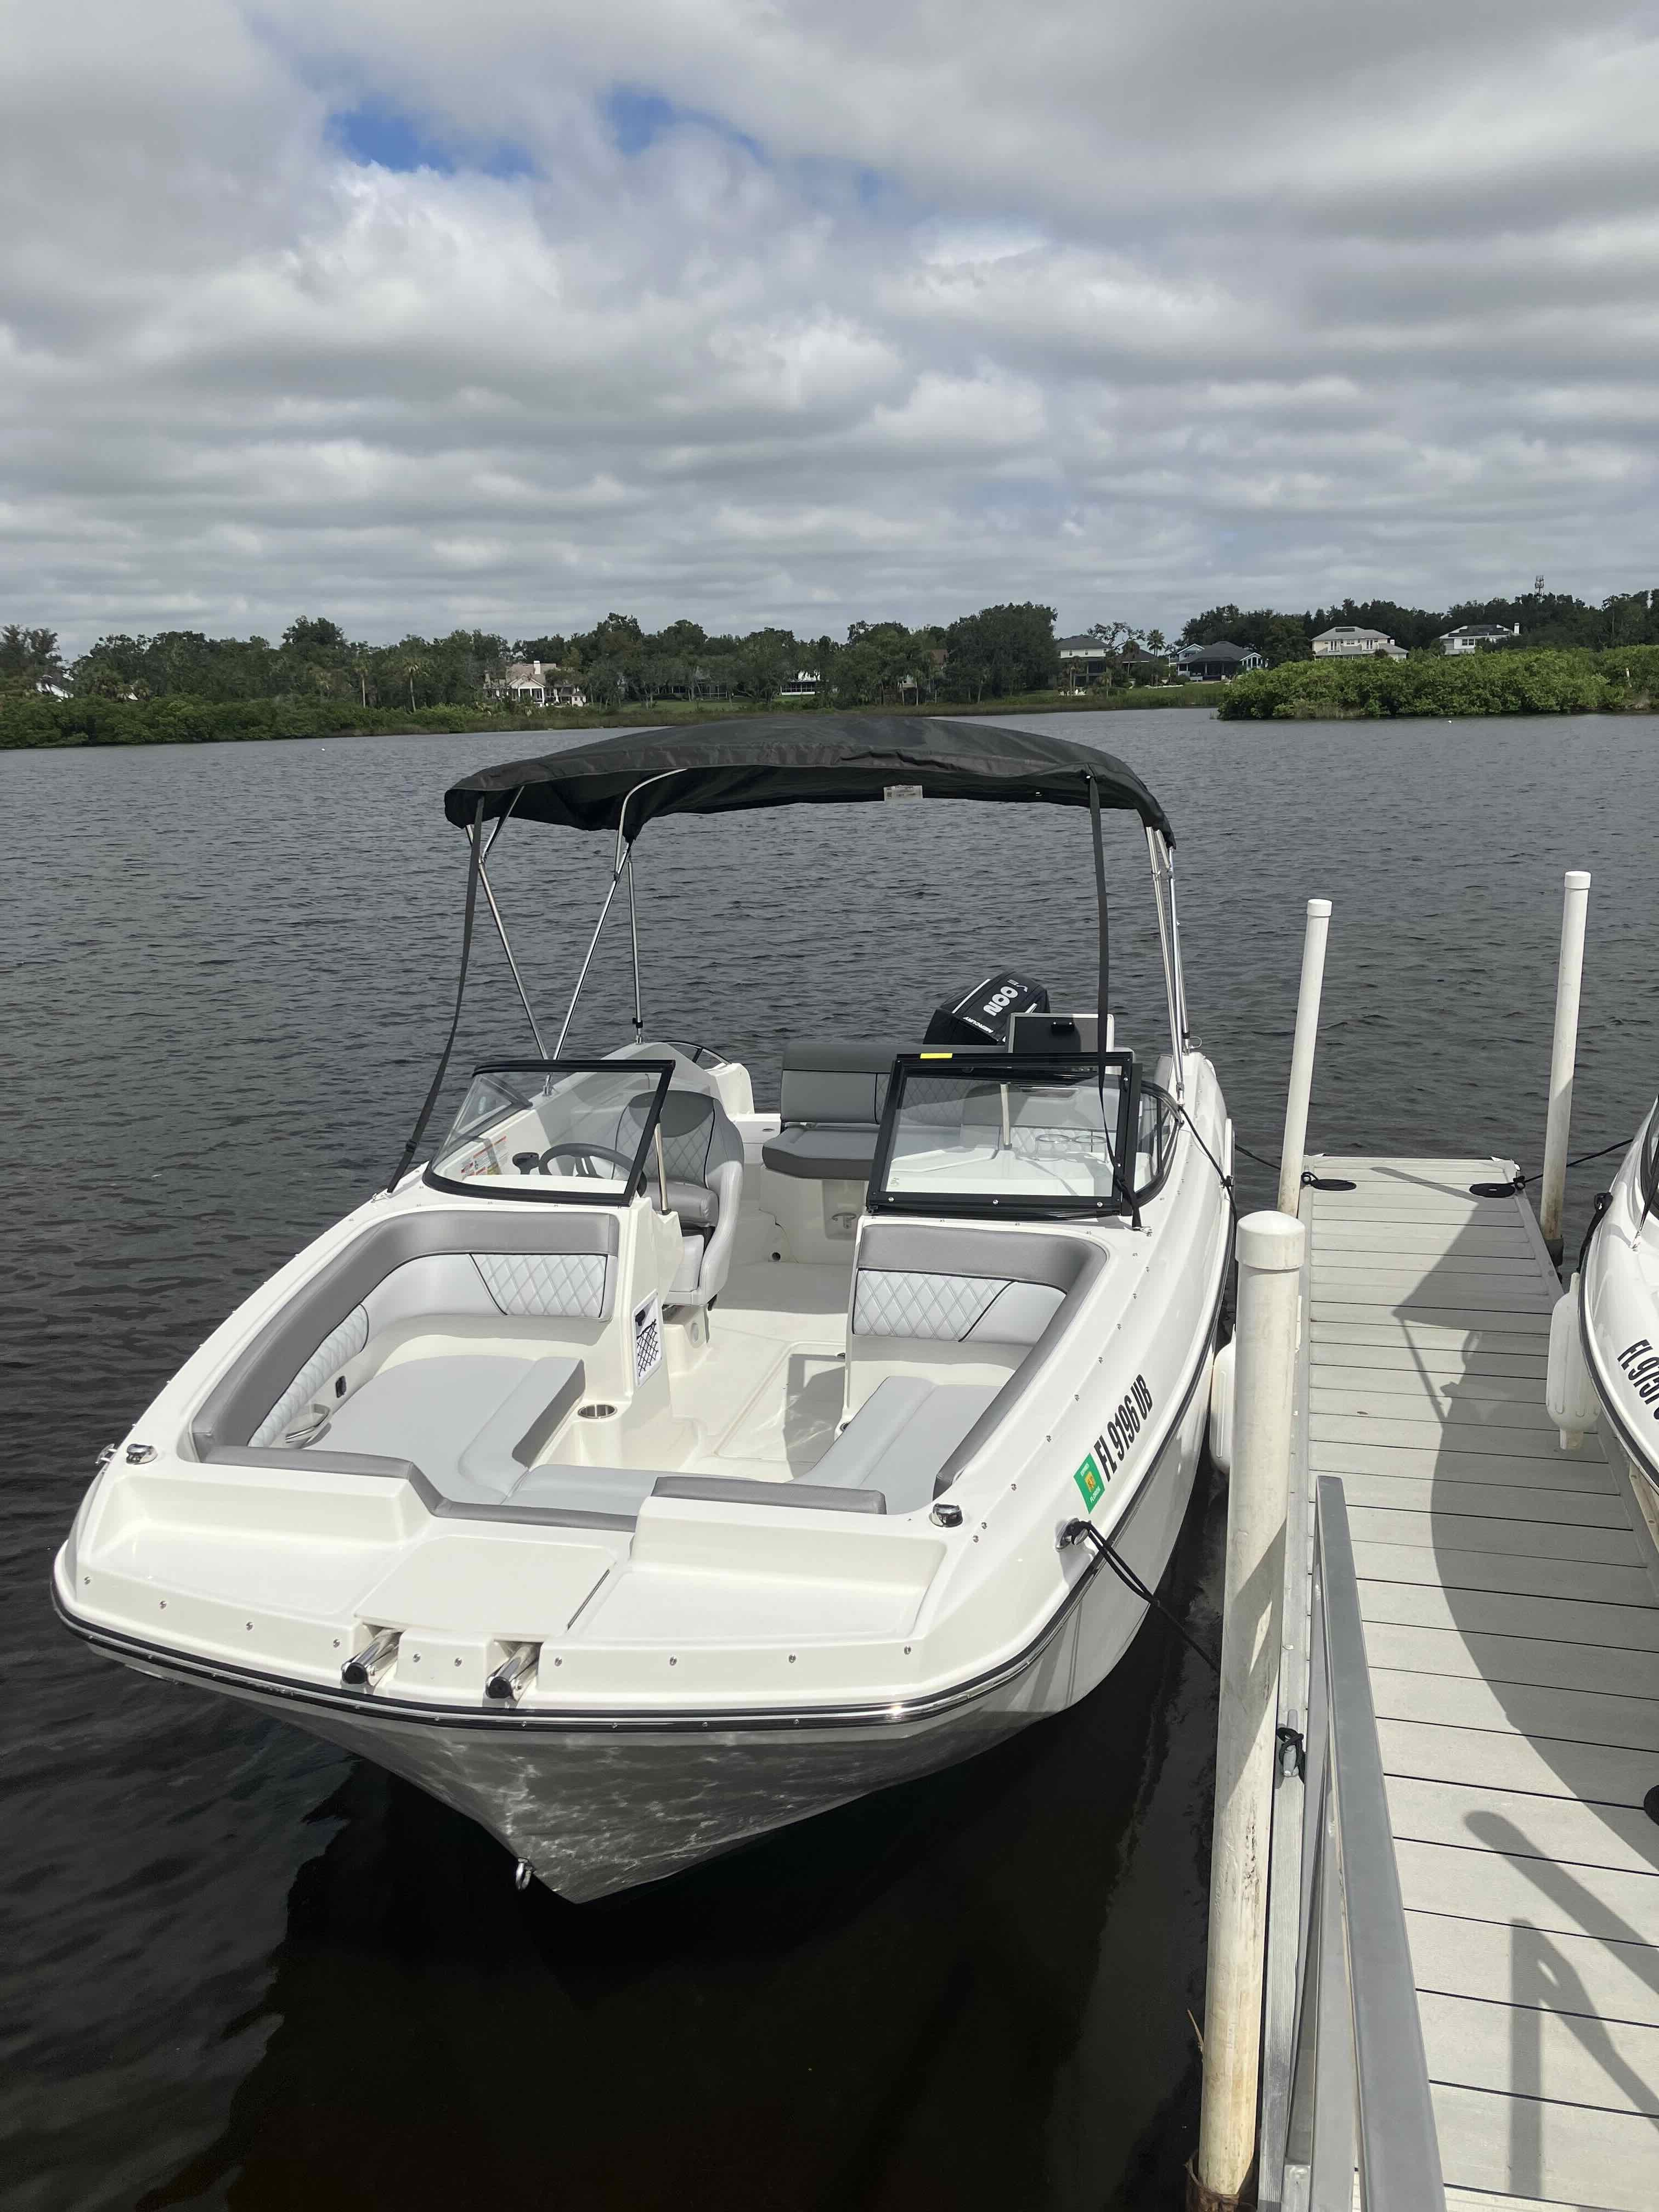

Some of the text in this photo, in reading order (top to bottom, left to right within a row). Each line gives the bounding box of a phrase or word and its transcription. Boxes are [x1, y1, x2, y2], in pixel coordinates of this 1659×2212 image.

[983, 986, 1018, 1016] 200
[963, 1017, 994, 1033] MERCURY
[1617, 1339, 1653, 1370] FL
[1093, 1374, 1153, 1482] FL 9196 UB
